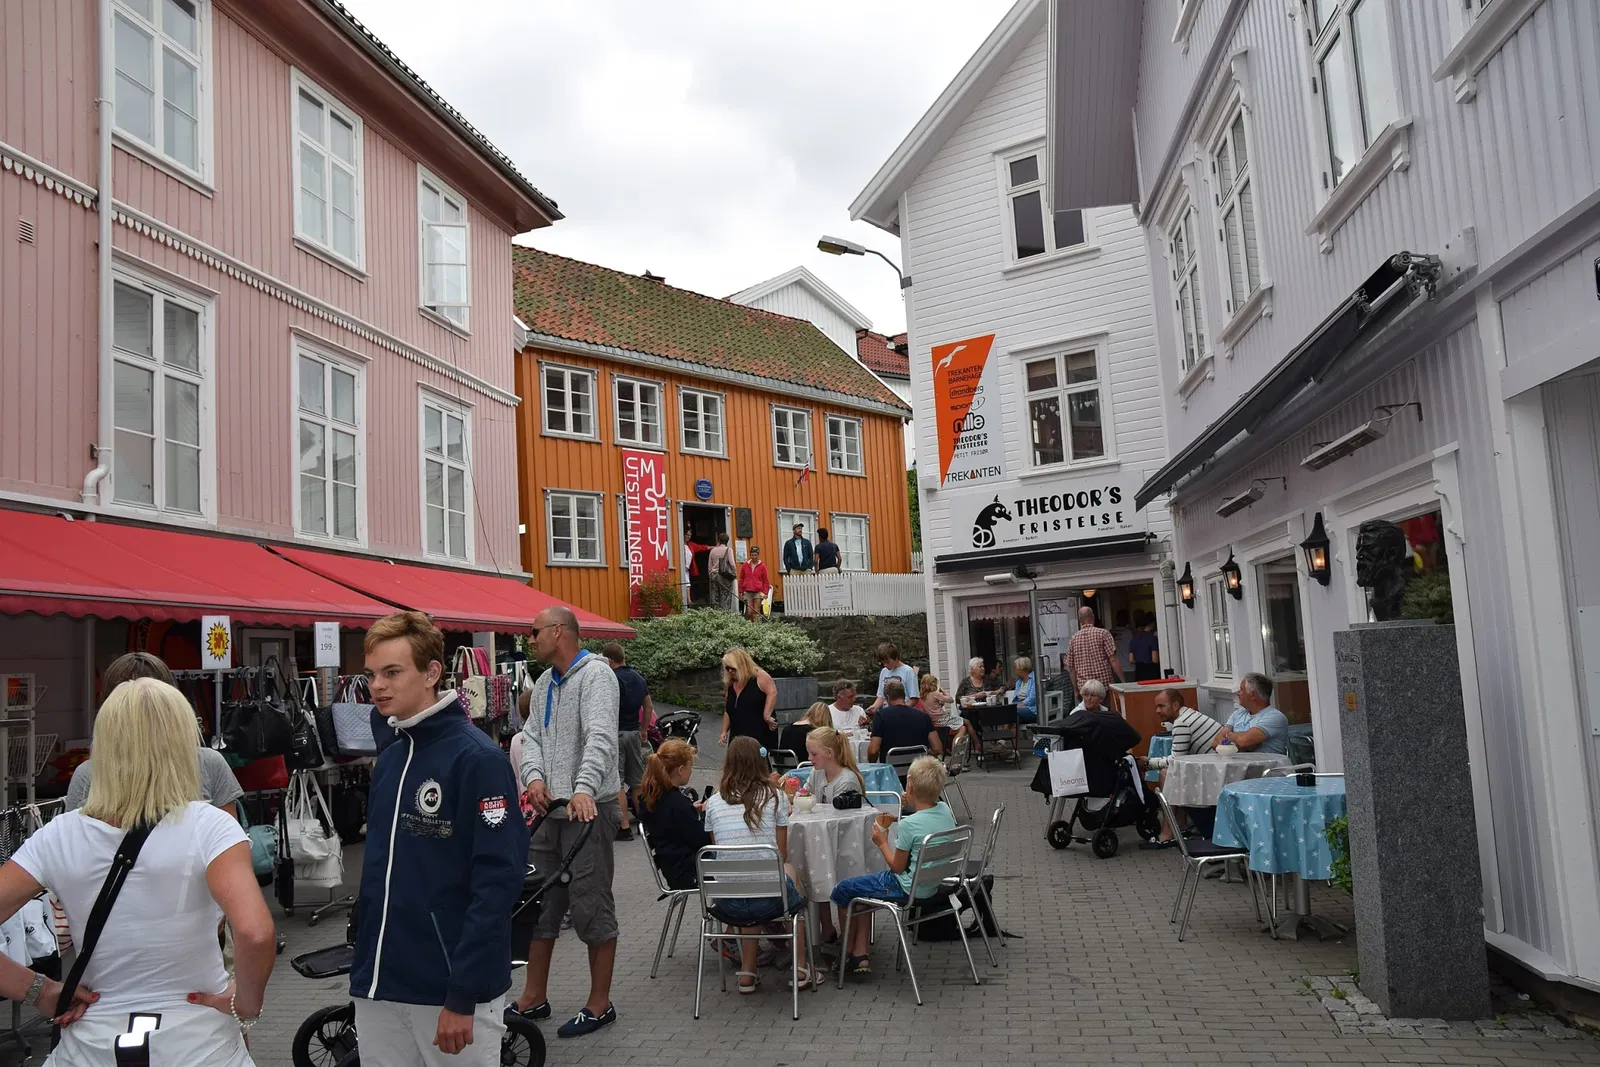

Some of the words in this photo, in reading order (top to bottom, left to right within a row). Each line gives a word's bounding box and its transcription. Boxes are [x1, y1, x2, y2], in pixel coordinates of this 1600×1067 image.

[947, 365, 983, 377] TREKANTEN
[948, 372, 983, 385] BARNEHAGE
[951, 385, 984, 397] strandberg
[953, 412, 985, 434] nille
[953, 432, 988, 445] THEODOR'S
[946, 465, 1002, 483] TREKANTEN
[1014, 486, 1122, 517] THEODOR'S
[625, 456, 643, 587] UTSTILLINGER
[1019, 511, 1124, 535] FRISTELSE
[320, 642, 336, 651] 199,-
